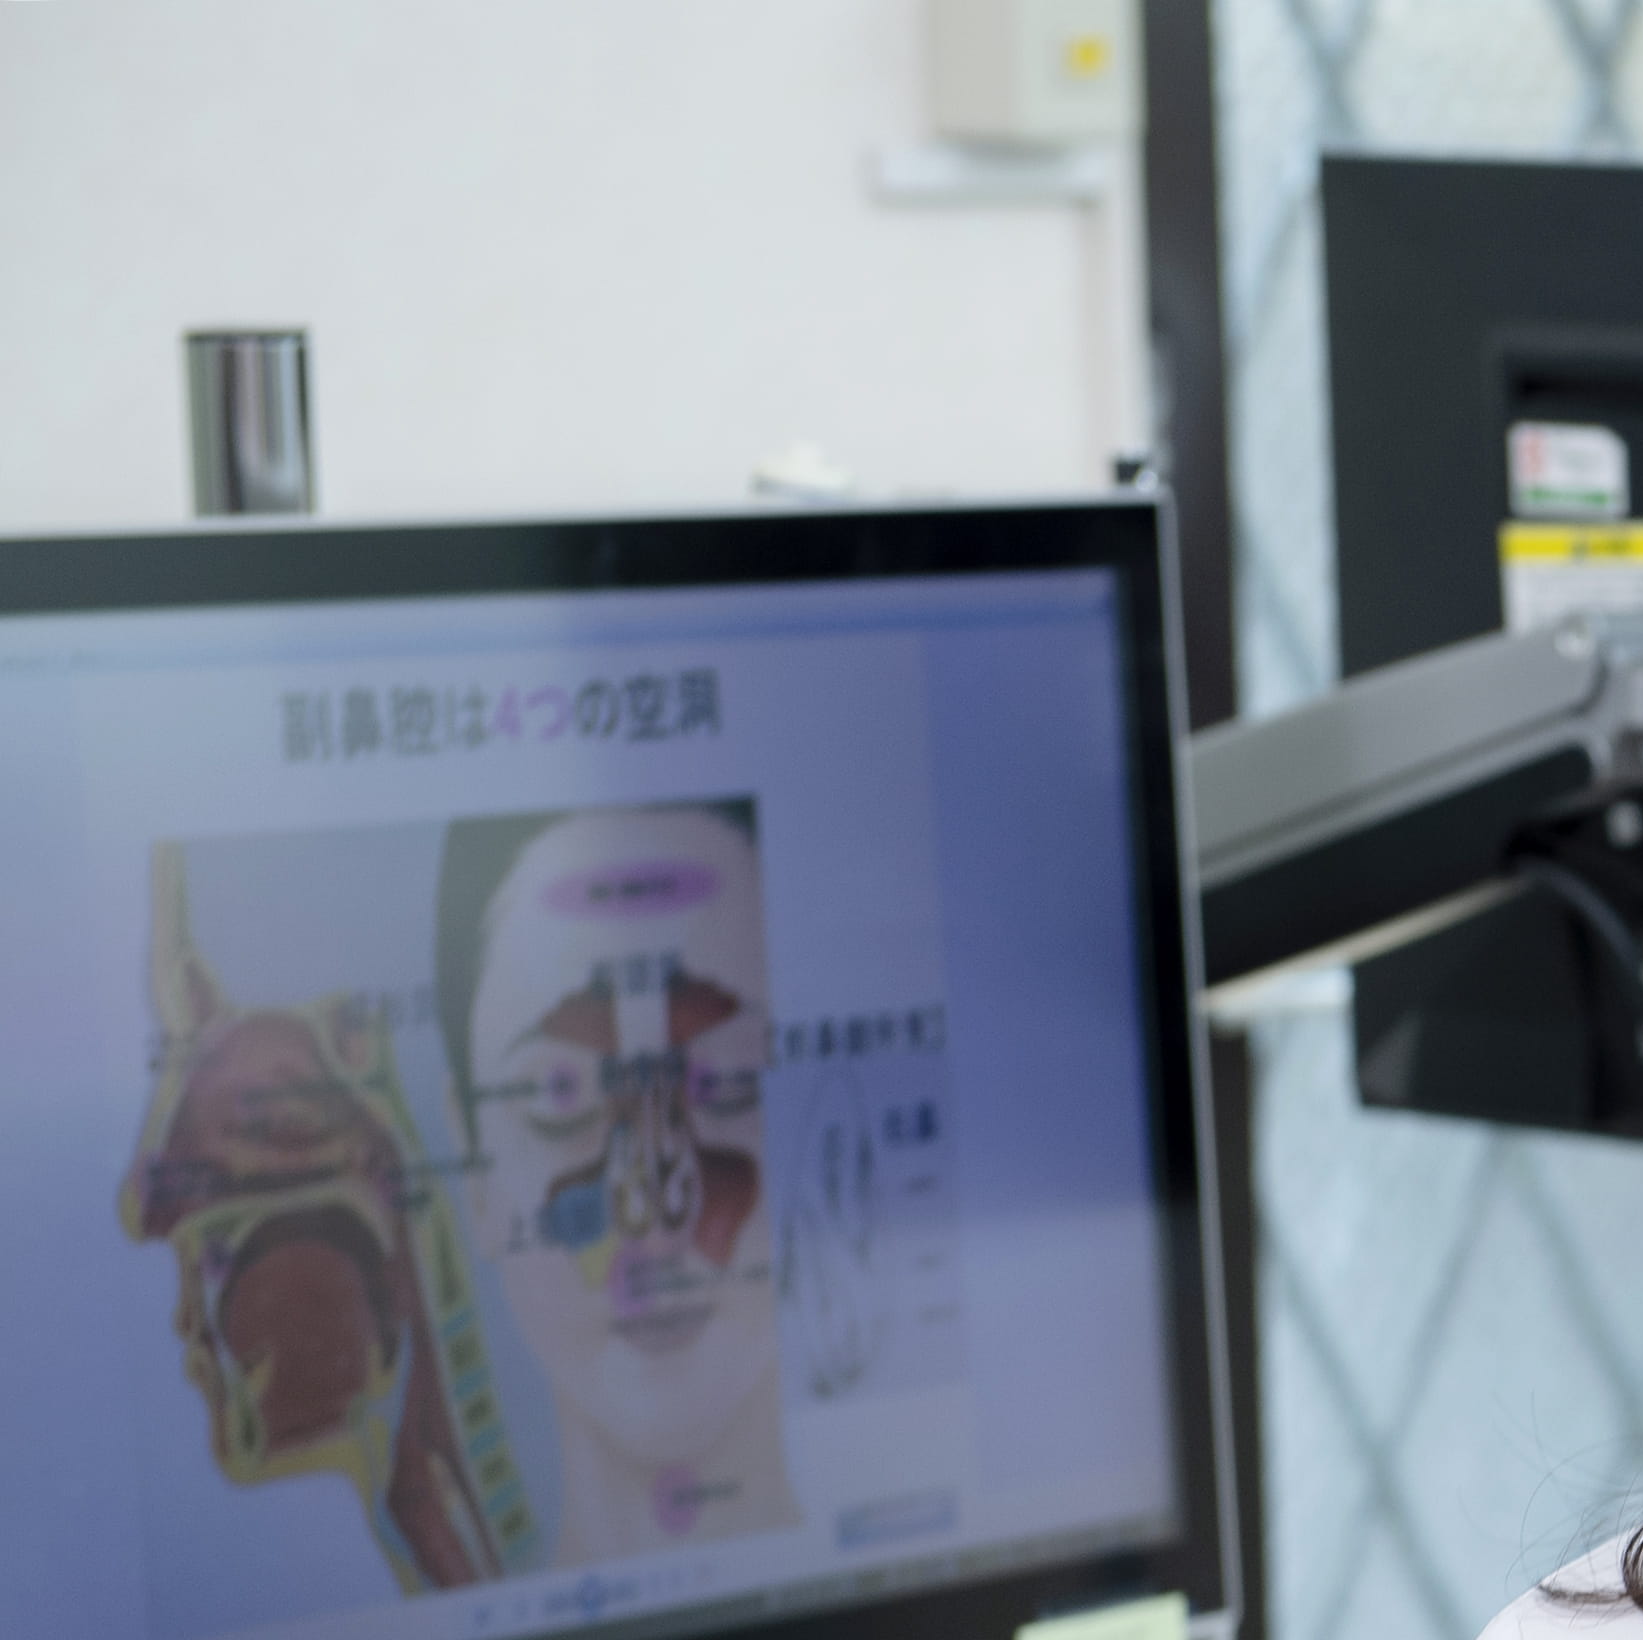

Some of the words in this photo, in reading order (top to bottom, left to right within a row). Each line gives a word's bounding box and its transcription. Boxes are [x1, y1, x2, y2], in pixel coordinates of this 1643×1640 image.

[281, 667, 721, 762] 副鼻腔は4つの空洞
